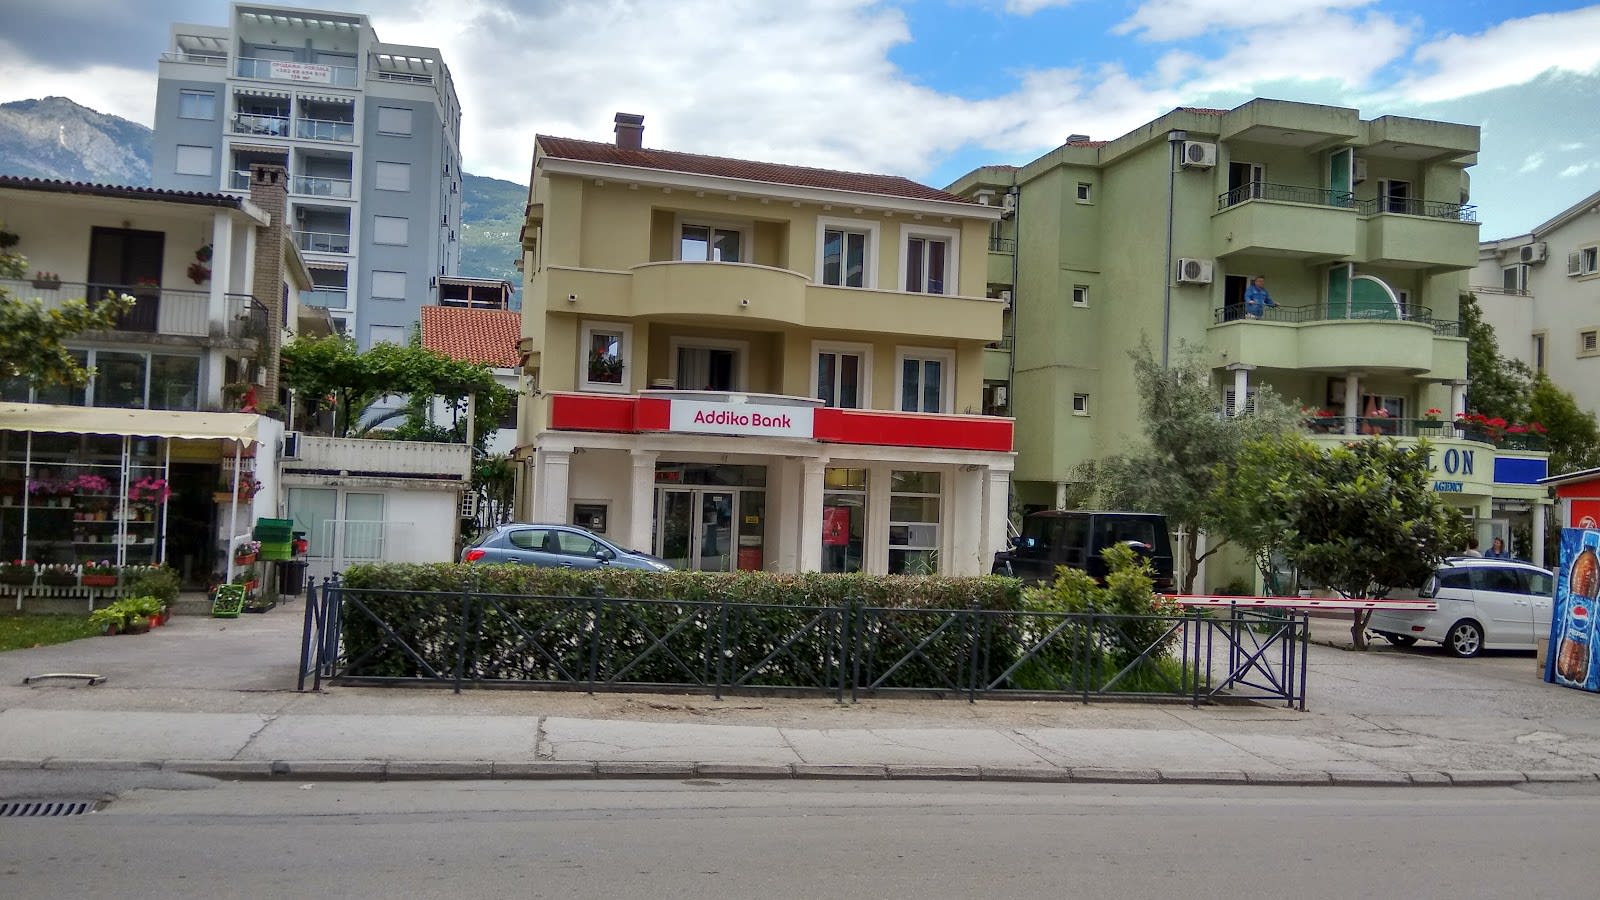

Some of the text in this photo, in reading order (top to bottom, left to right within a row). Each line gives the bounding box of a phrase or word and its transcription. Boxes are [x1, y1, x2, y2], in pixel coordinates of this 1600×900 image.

[694, 410, 791, 428] Addiko Bank
[1433, 481, 1464, 493] AGENCY
